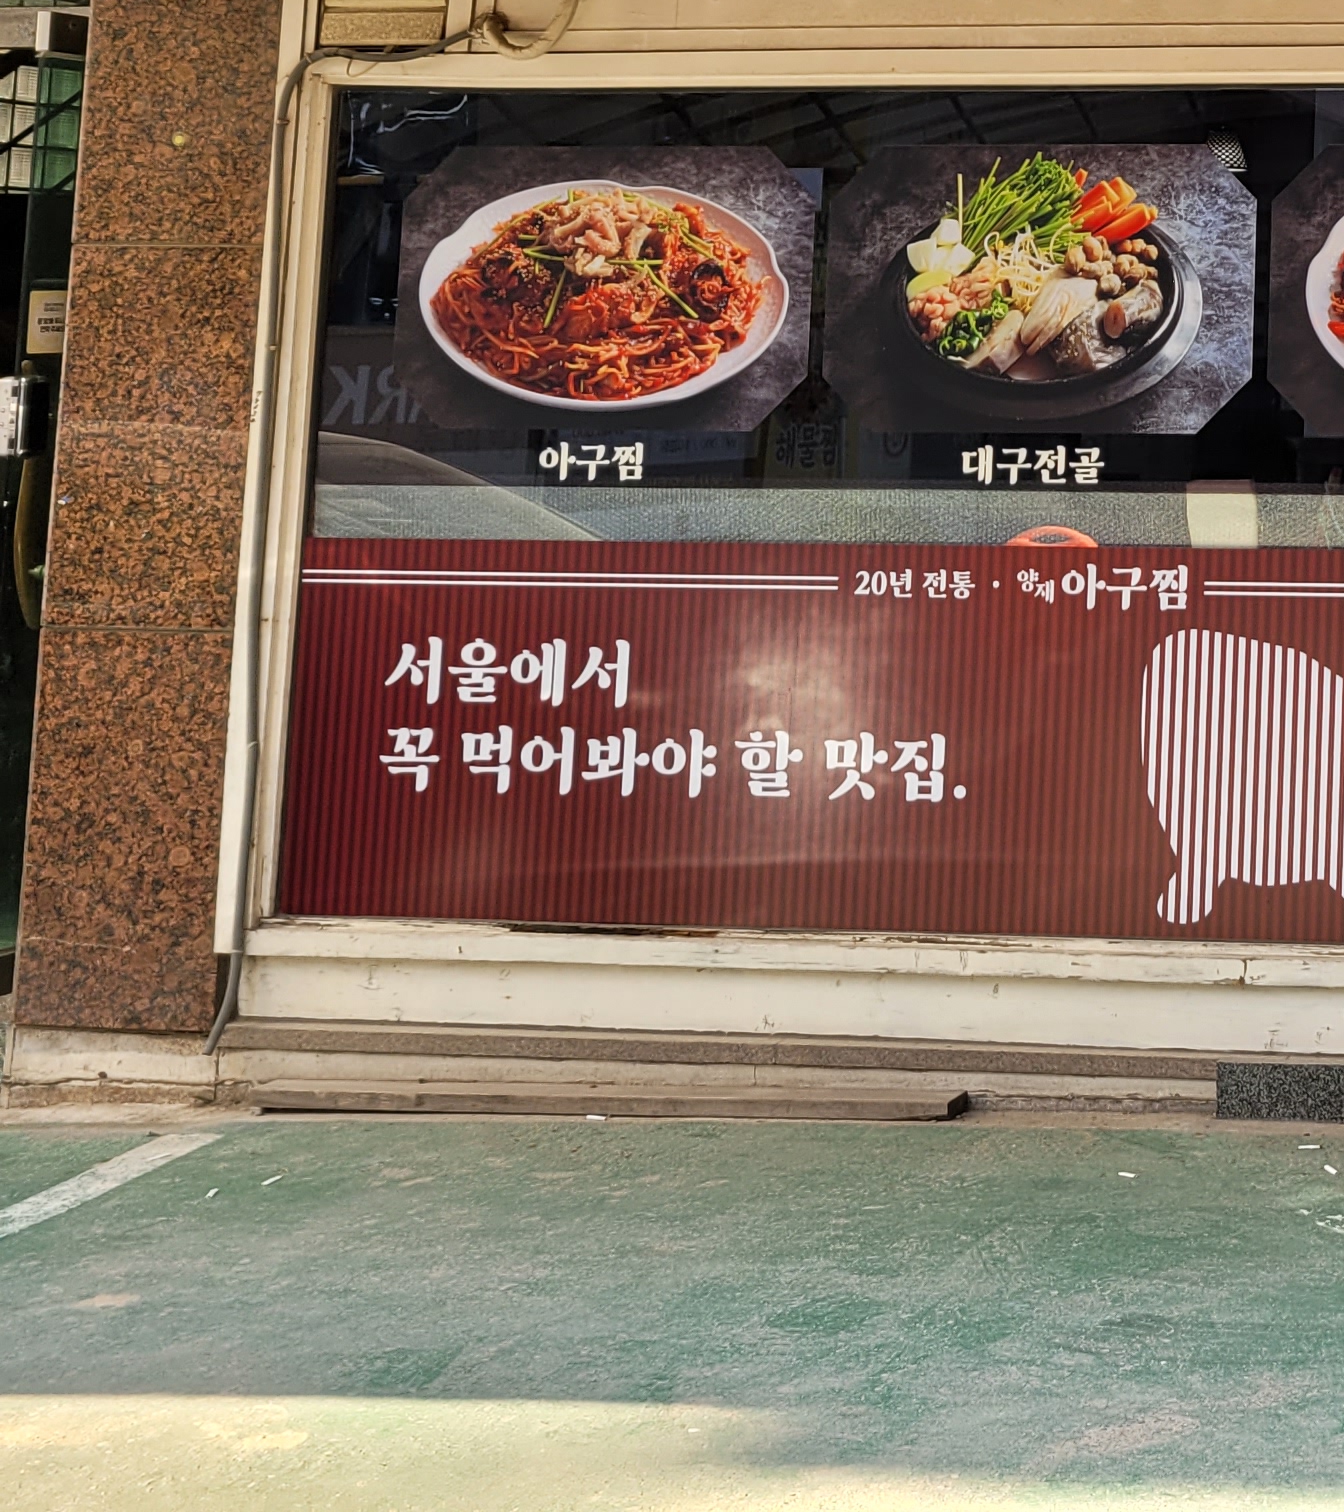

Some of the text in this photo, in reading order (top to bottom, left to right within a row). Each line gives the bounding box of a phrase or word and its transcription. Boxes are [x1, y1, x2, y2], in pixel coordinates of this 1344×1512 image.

[539, 442, 644, 482] 아구찜
[962, 447, 1105, 486] 대구전골
[854, 563, 1188, 610] 20년 전통 양재 아구찜
[385, 636, 629, 708] 서울에서
[379, 727, 968, 801] 꼭 먹어봐야 할 맛집.
